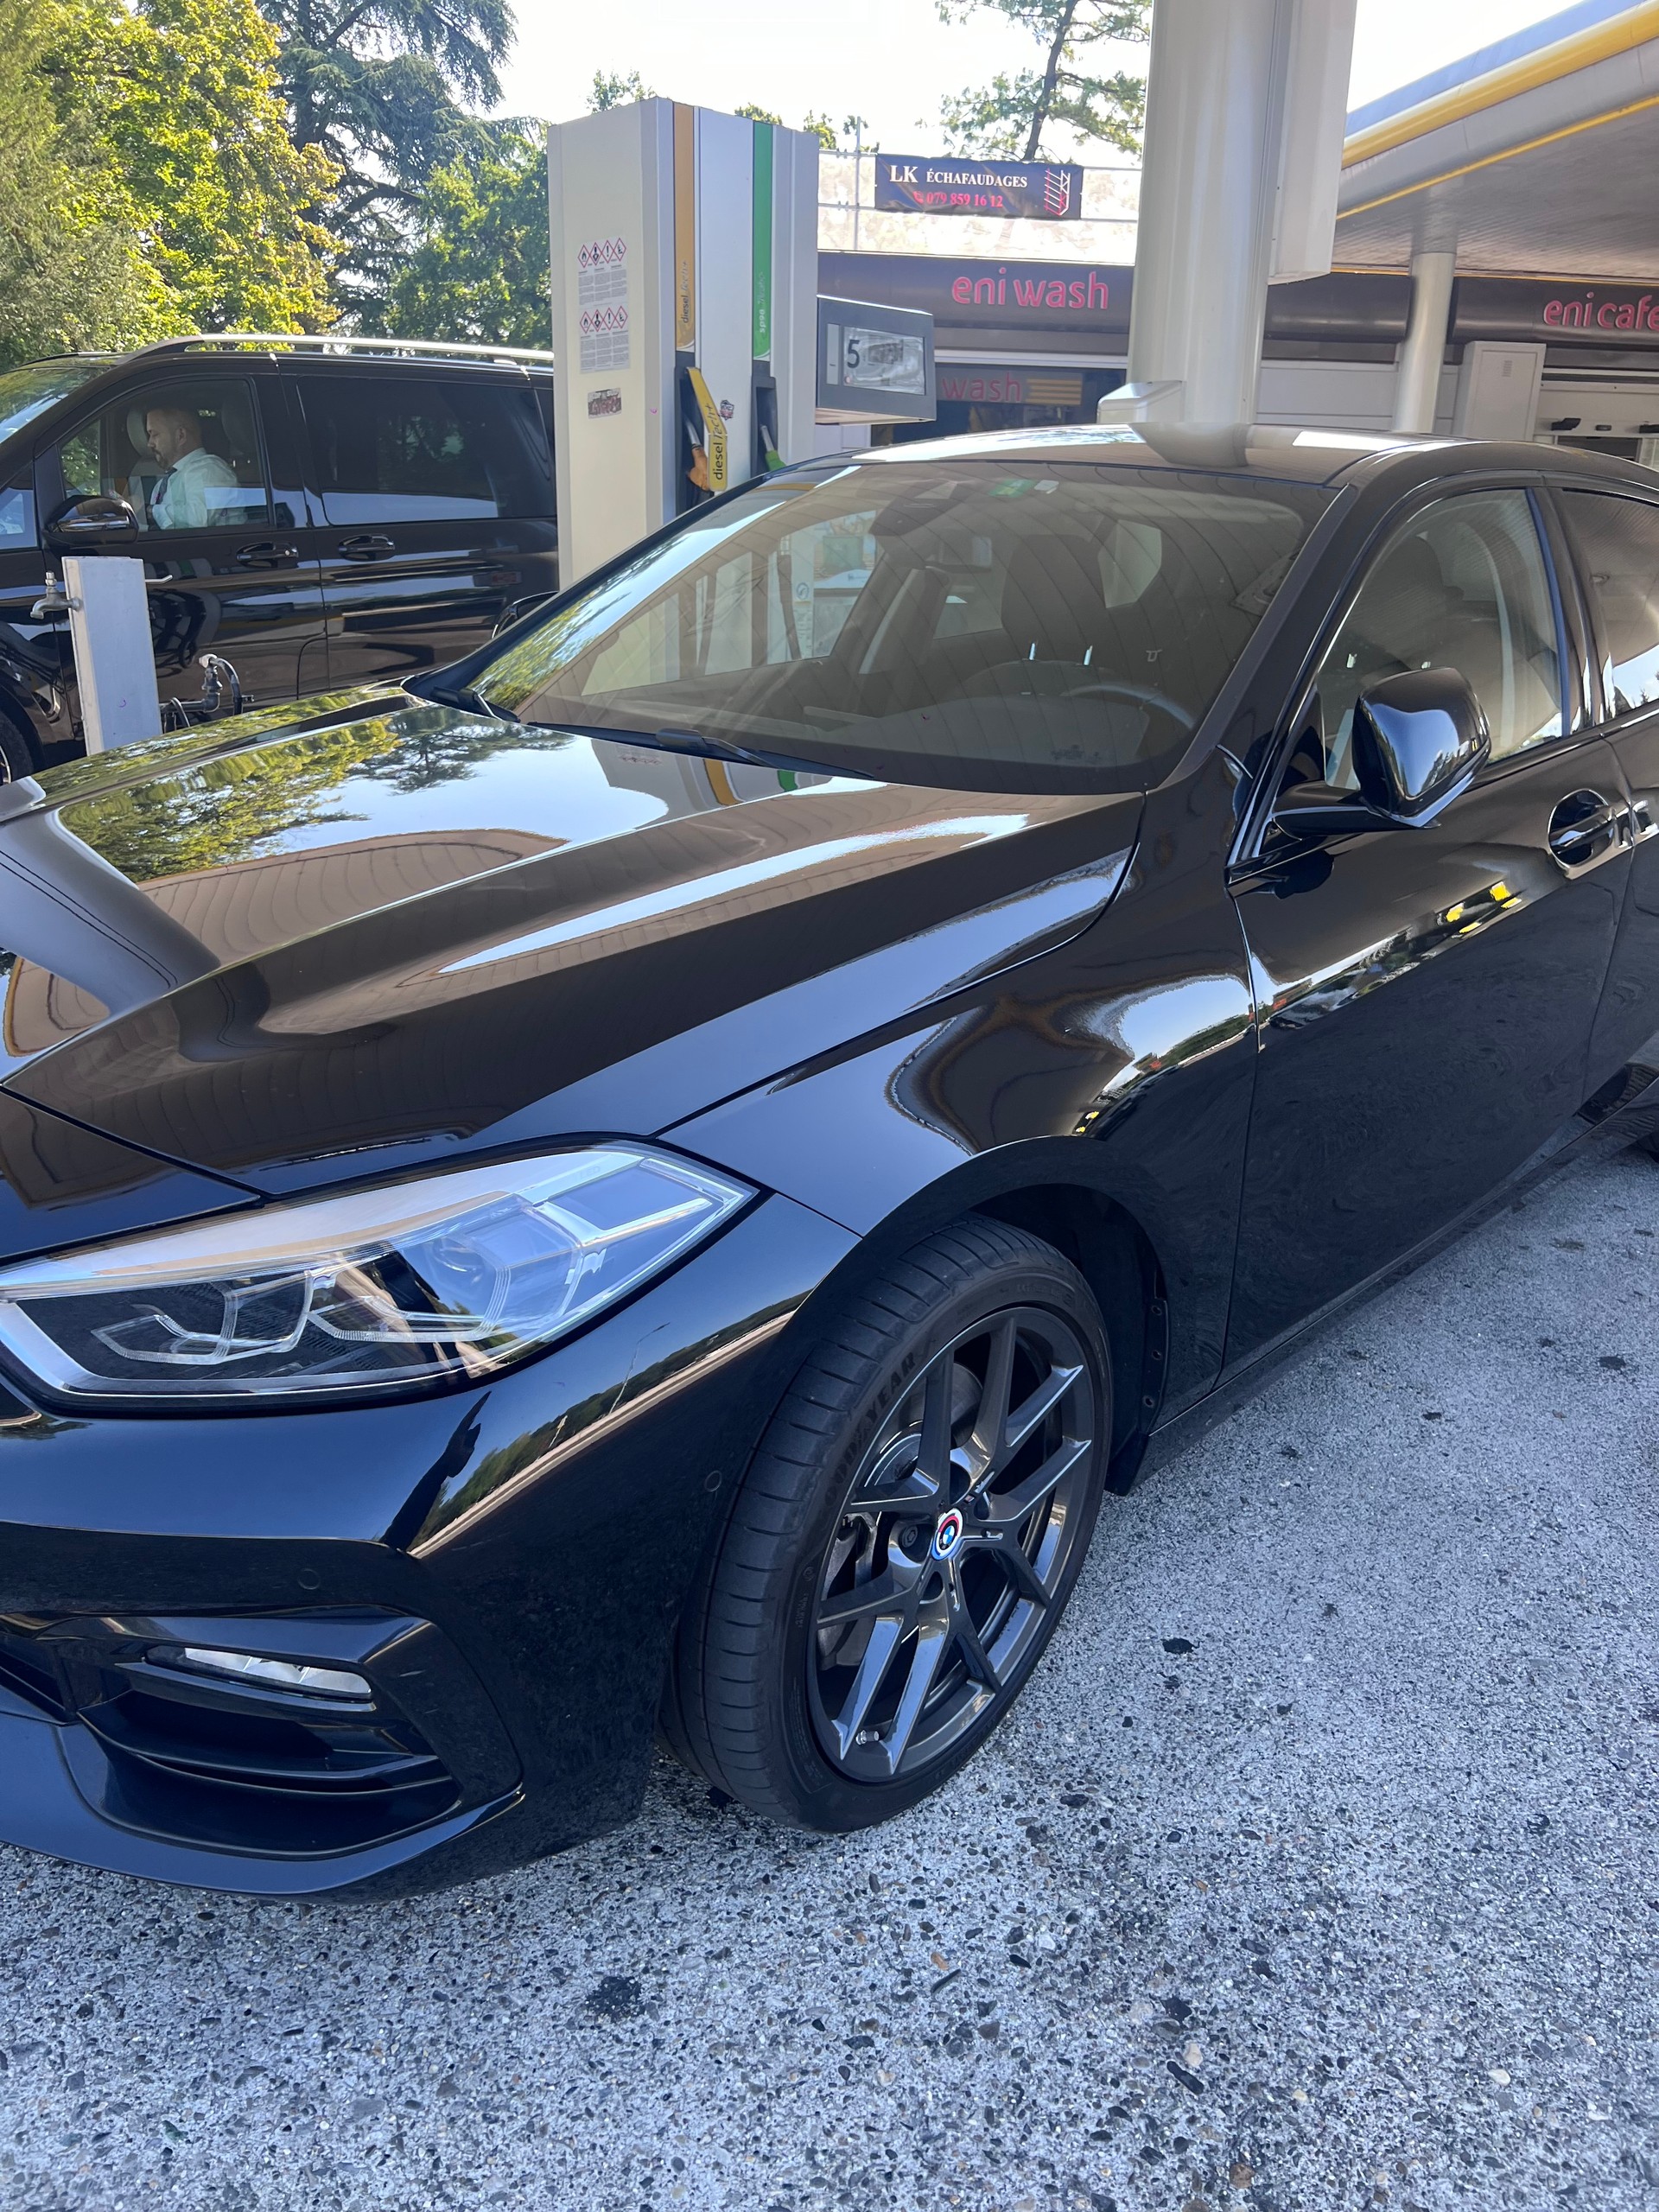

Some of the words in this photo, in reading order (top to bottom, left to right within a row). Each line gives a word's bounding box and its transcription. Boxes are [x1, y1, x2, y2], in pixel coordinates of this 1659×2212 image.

[889, 165, 918, 183] LK
[926, 168, 1027, 188] ÉCHAFAUDAGES
[926, 192, 946, 204] 079
[950, 193, 970, 206] 859
[974, 194, 987, 207] 16
[990, 194, 1003, 207] 12
[952, 267, 1007, 305] eni
[1014, 271, 1109, 309] wash
[680, 295, 690, 323] diesel
[1543, 291, 1594, 327] eni
[847, 340, 861, 369] 5
[941, 372, 1022, 402] wash
[713, 442, 723, 480] diesel
